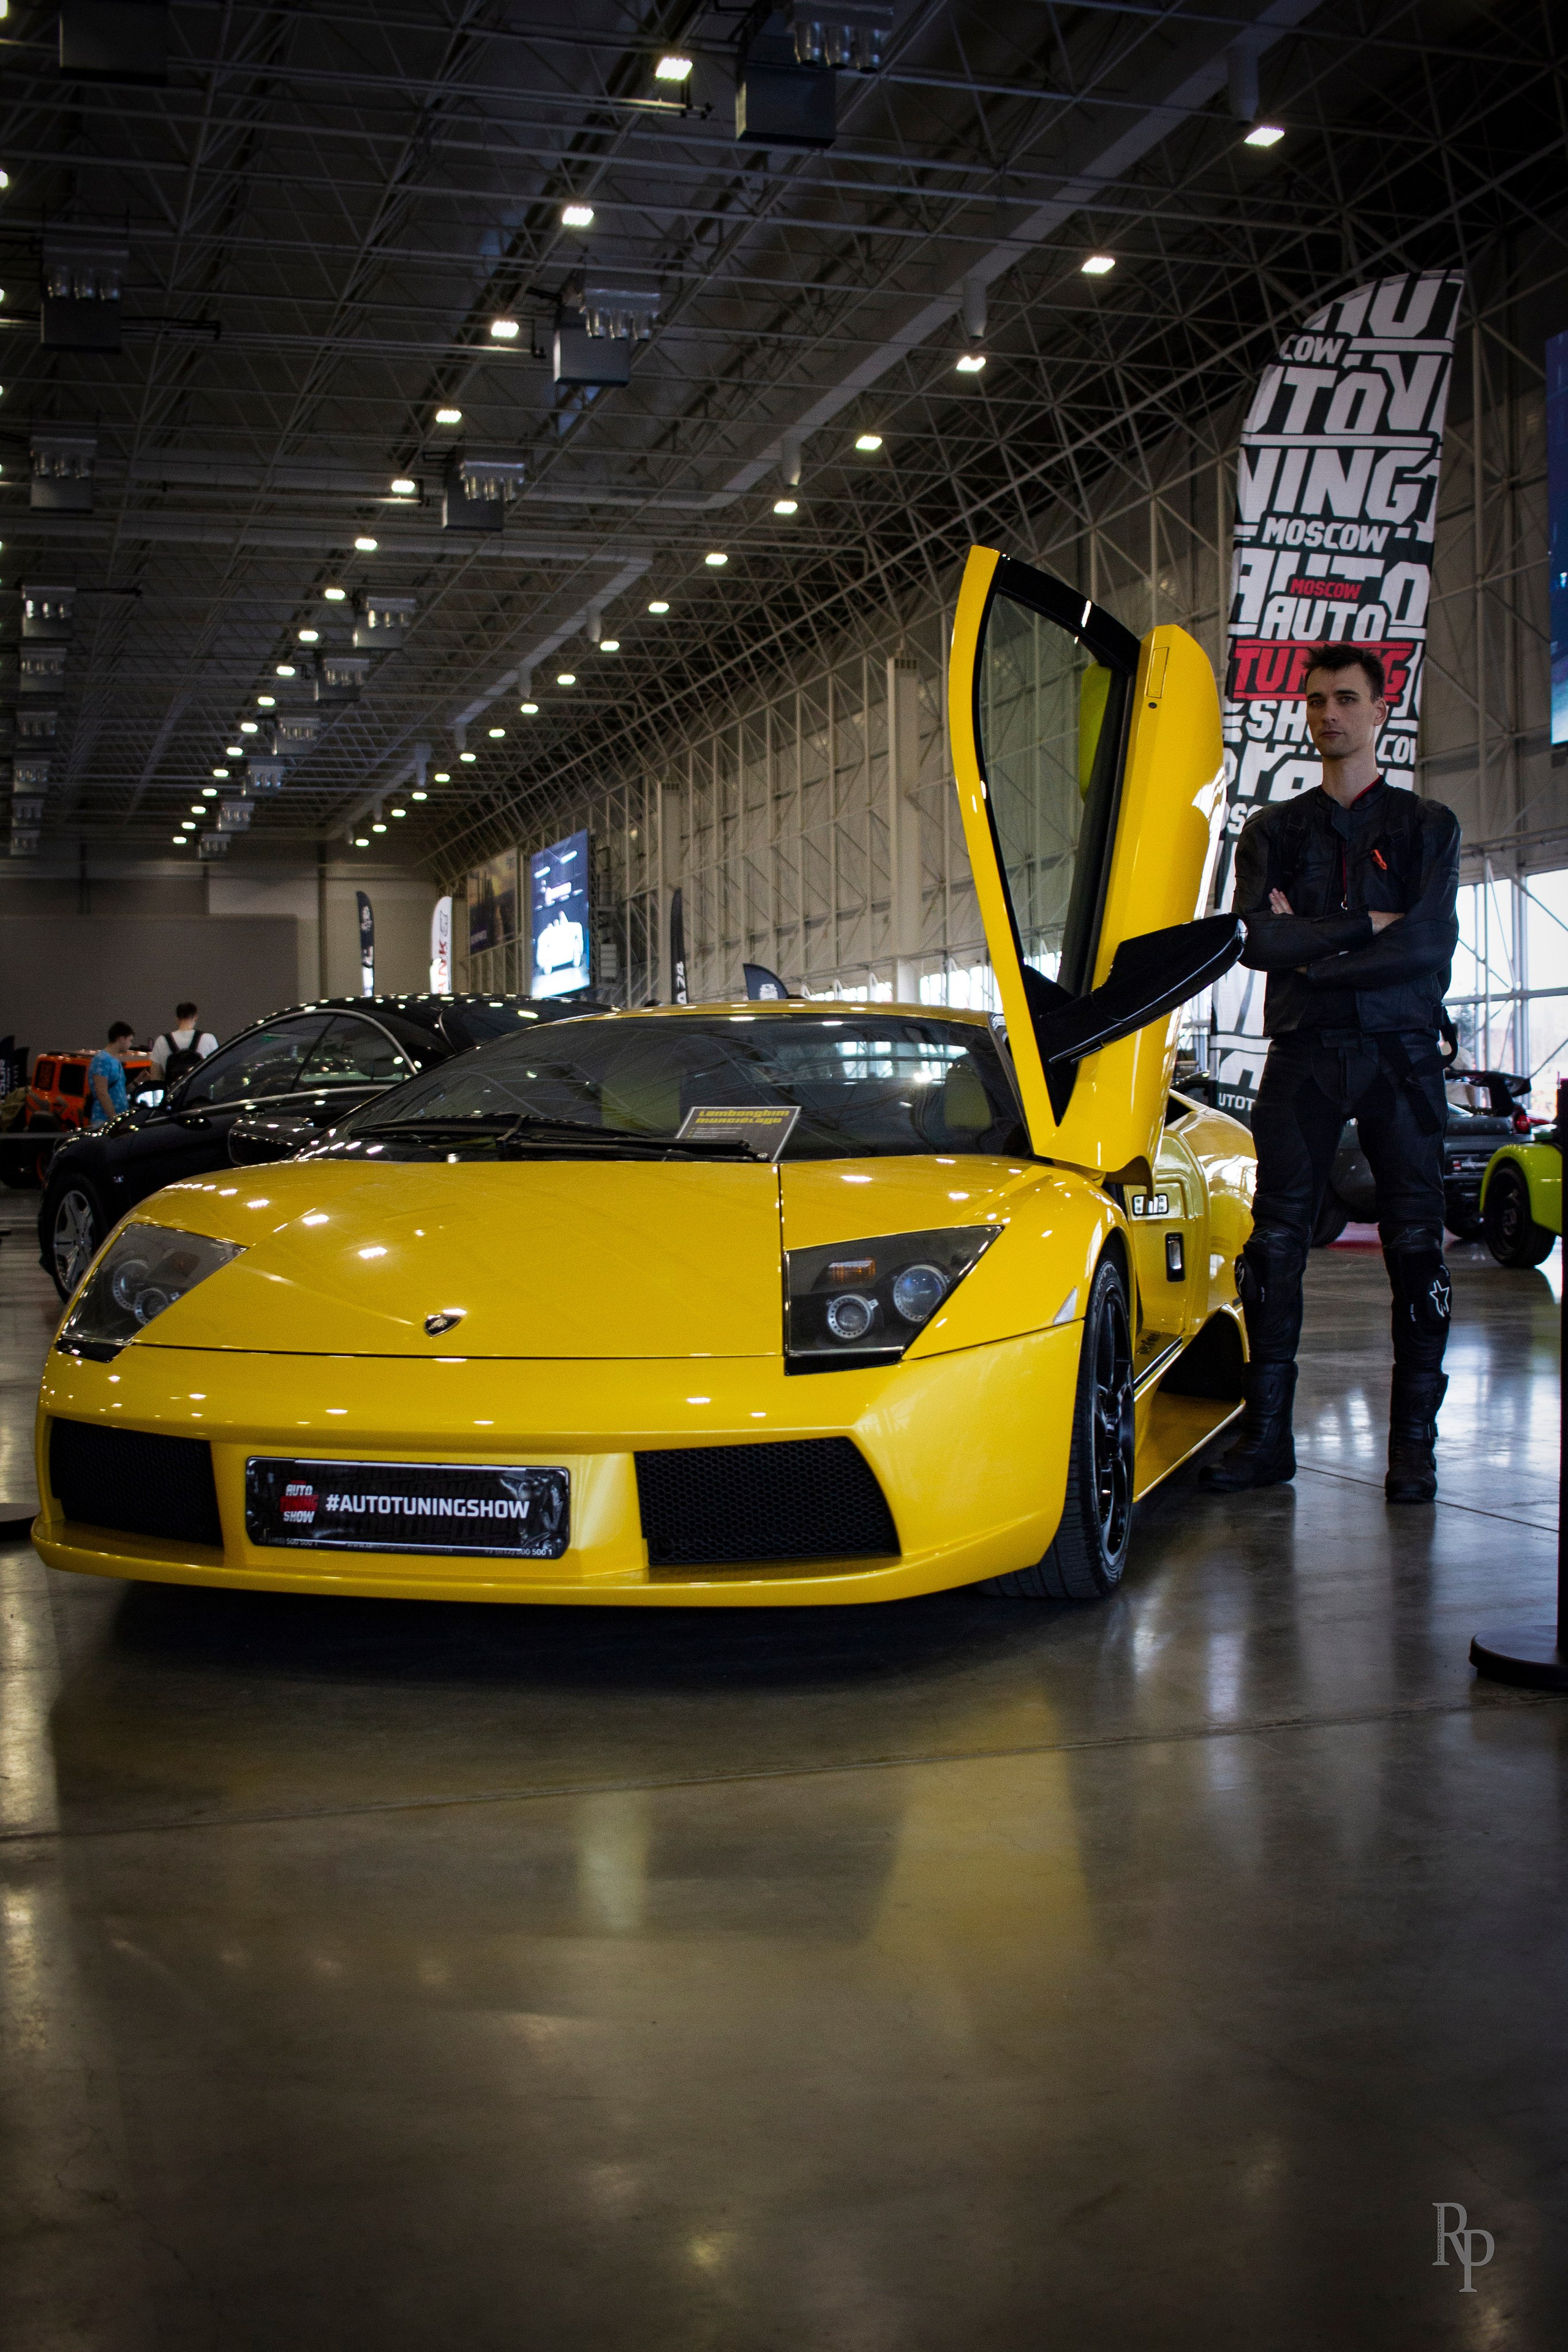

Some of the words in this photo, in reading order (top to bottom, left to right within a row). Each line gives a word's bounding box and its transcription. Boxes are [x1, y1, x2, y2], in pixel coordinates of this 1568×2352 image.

[1262, 516, 1390, 552] MOSCOW
[1289, 578, 1362, 600] MOSCOW
[1259, 595, 1387, 641] AUTO
[285, 1484, 313, 1496] AUTO
[283, 1510, 315, 1523] SHOW
[325, 1494, 530, 1519] #AUTOTUNINGSHOW
